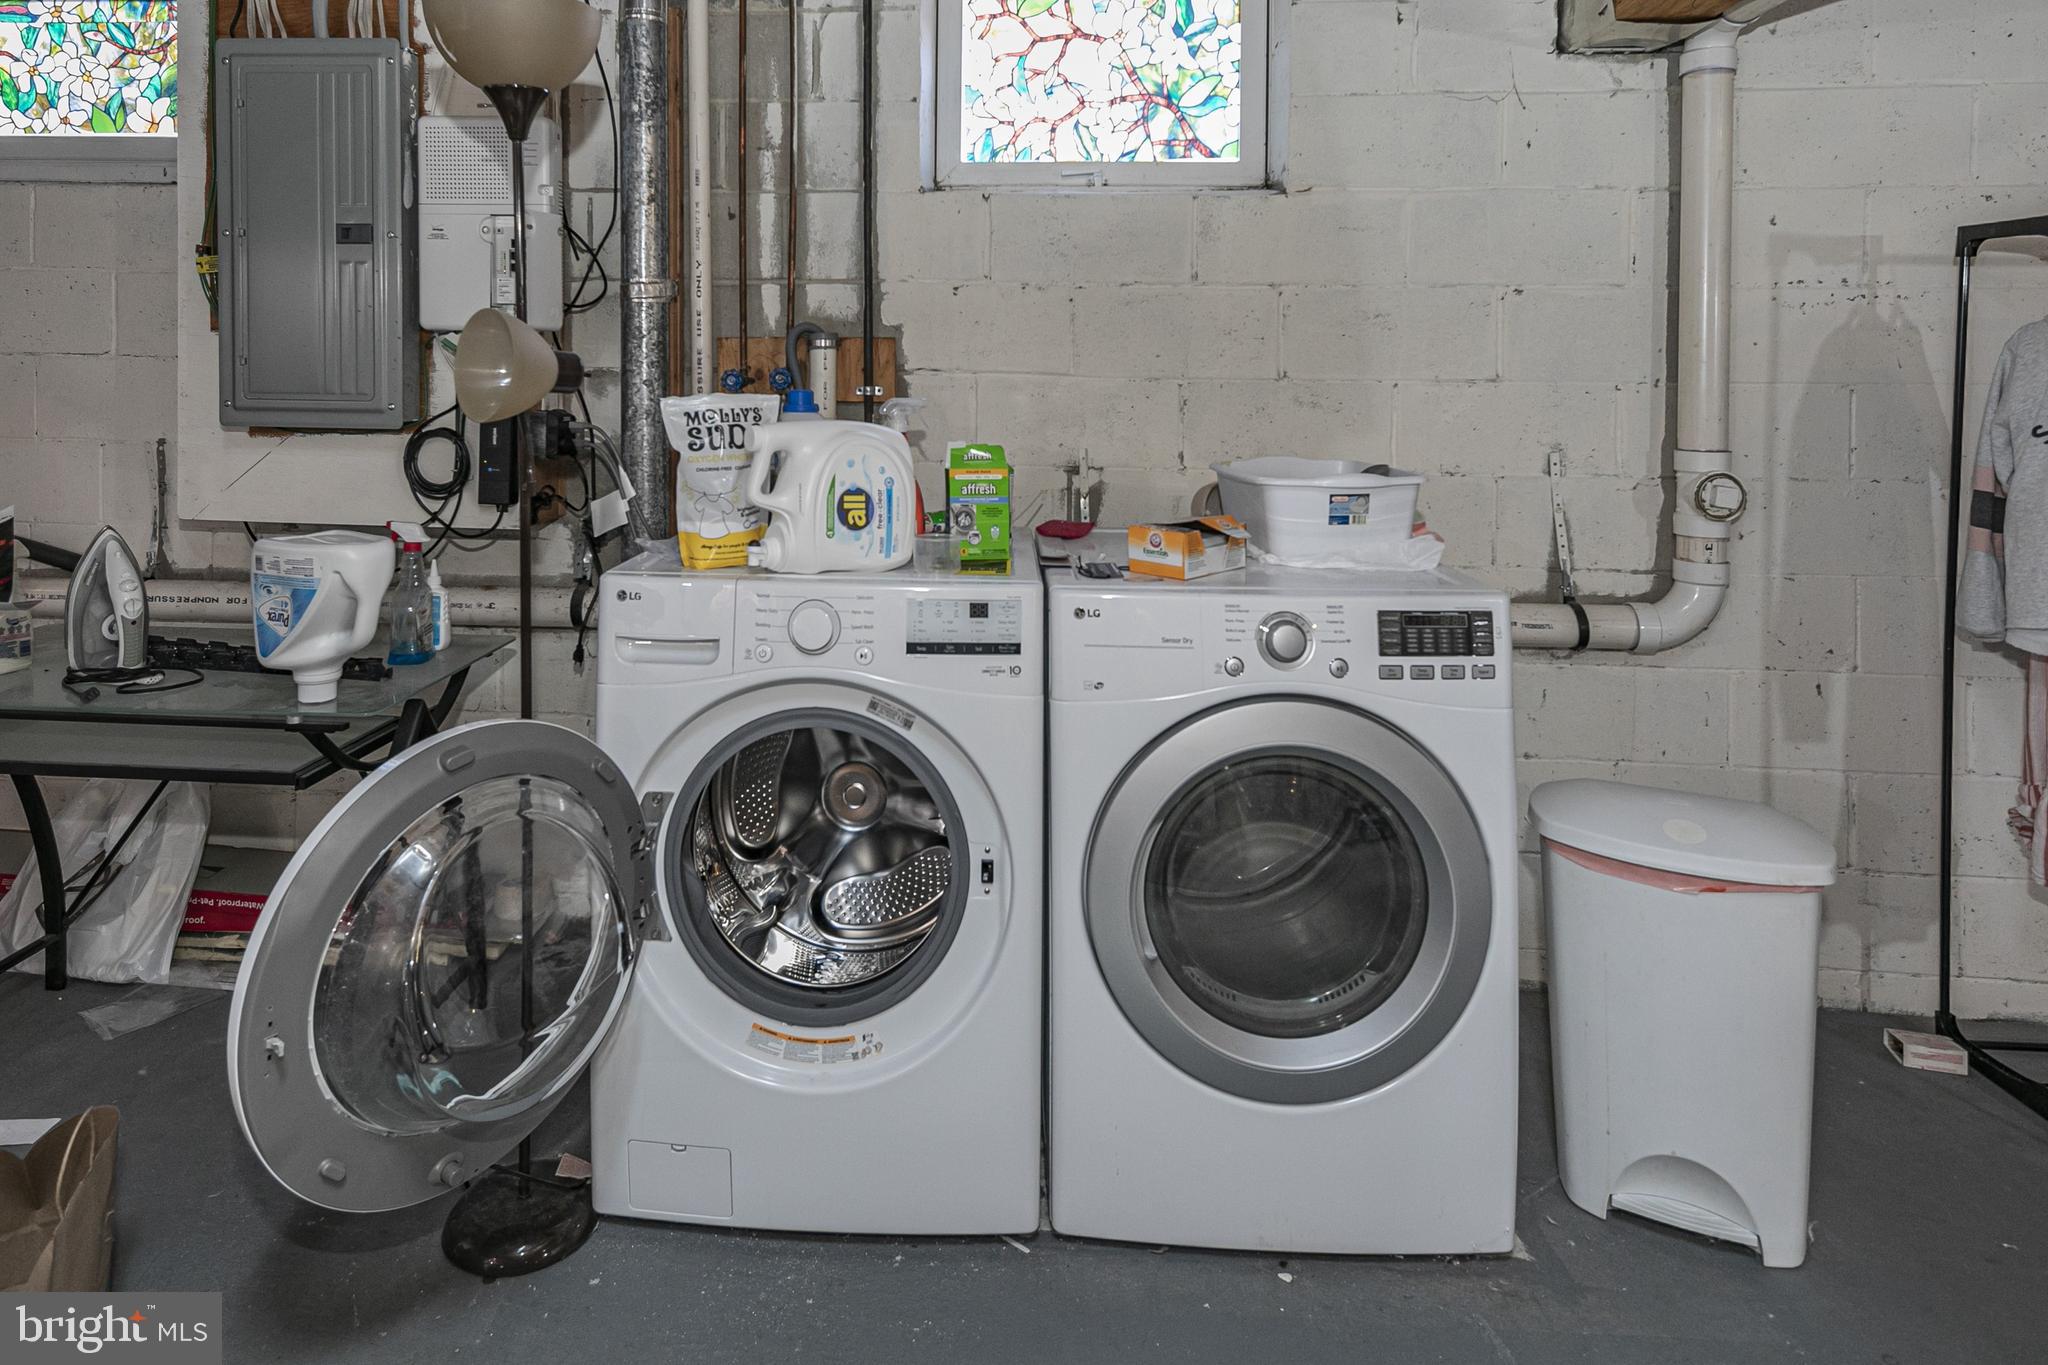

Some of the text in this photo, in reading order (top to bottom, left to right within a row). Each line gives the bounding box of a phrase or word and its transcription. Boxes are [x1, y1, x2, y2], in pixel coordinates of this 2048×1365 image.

[684, 407, 763, 427] MOLLY'S
[687, 422, 761, 452] SUD
[961, 483, 996, 495] affresh
[842, 494, 867, 527] all
[226, 597, 248, 605] FOR
[629, 592, 642, 601] LG
[1087, 608, 1101, 618] LG
[267, 610, 290, 628] Purex
[1161, 636, 1193, 645] Sensor Dry
[184, 915, 206, 925] roof.
